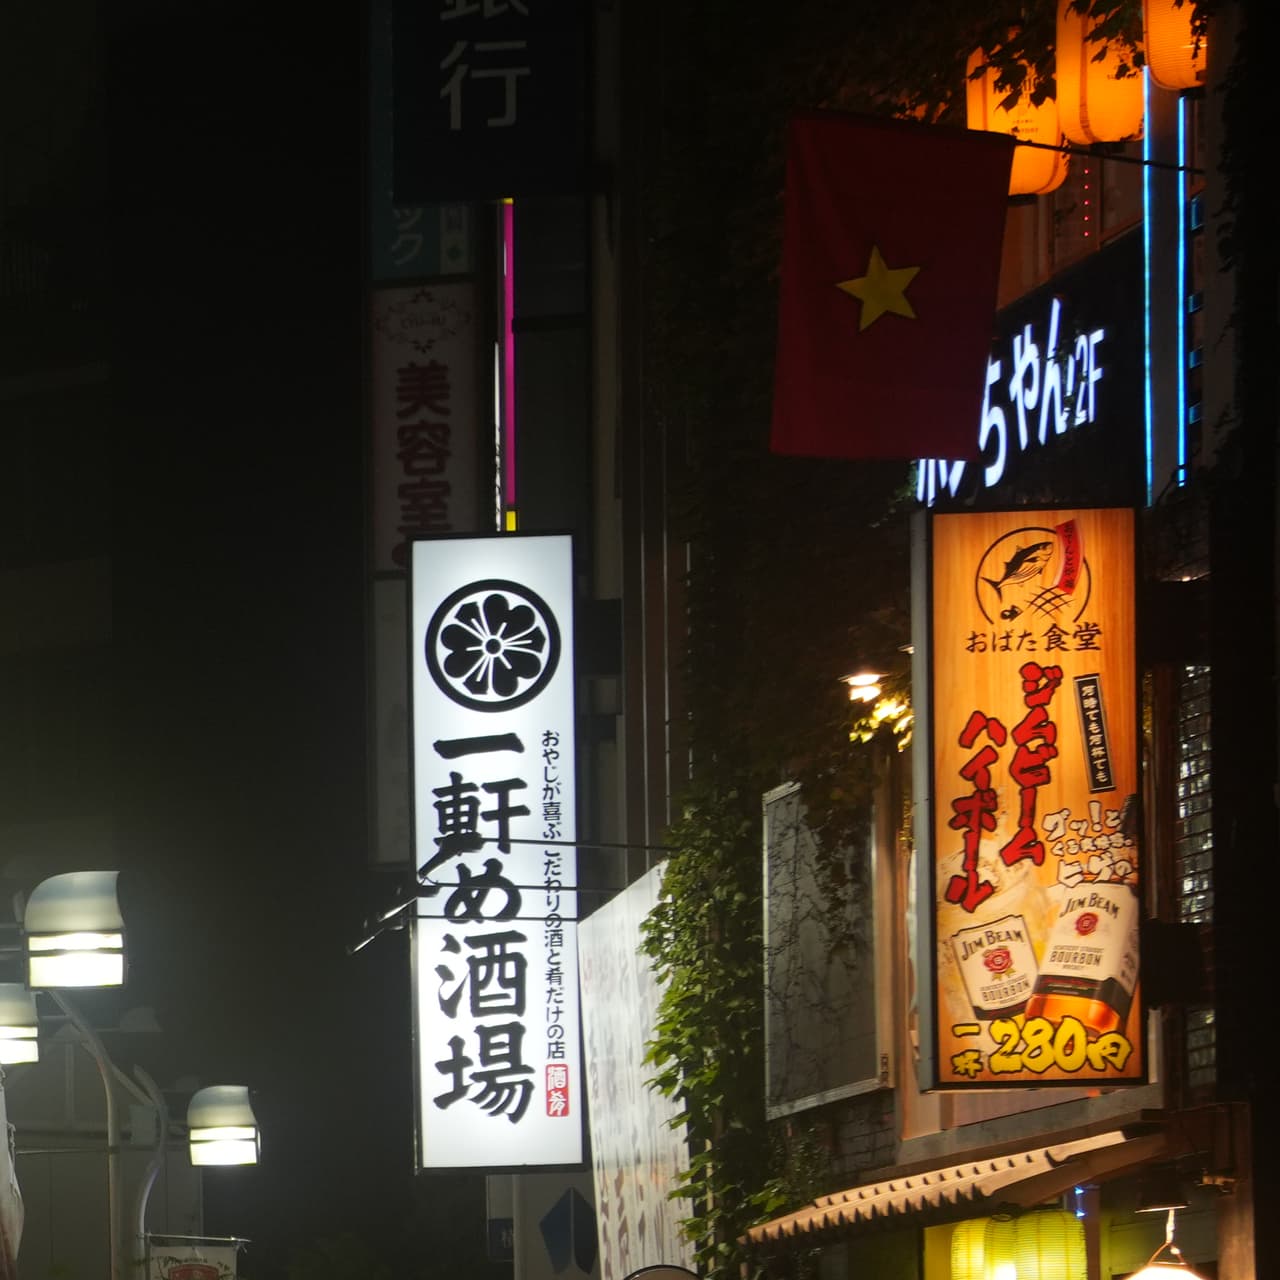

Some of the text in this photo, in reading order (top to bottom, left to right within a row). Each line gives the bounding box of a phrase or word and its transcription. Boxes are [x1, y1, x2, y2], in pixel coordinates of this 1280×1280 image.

[439, 0, 531, 131] 行
[395, 360, 452, 534] 美容室
[965, 621, 1103, 653] おばた食堂
[944, 710, 1008, 913] ハイボール
[999, 661, 1064, 867] ジムビーム
[431, 732, 536, 1125] 一軒め酒場
[989, 1014, 1133, 1074] 280円
